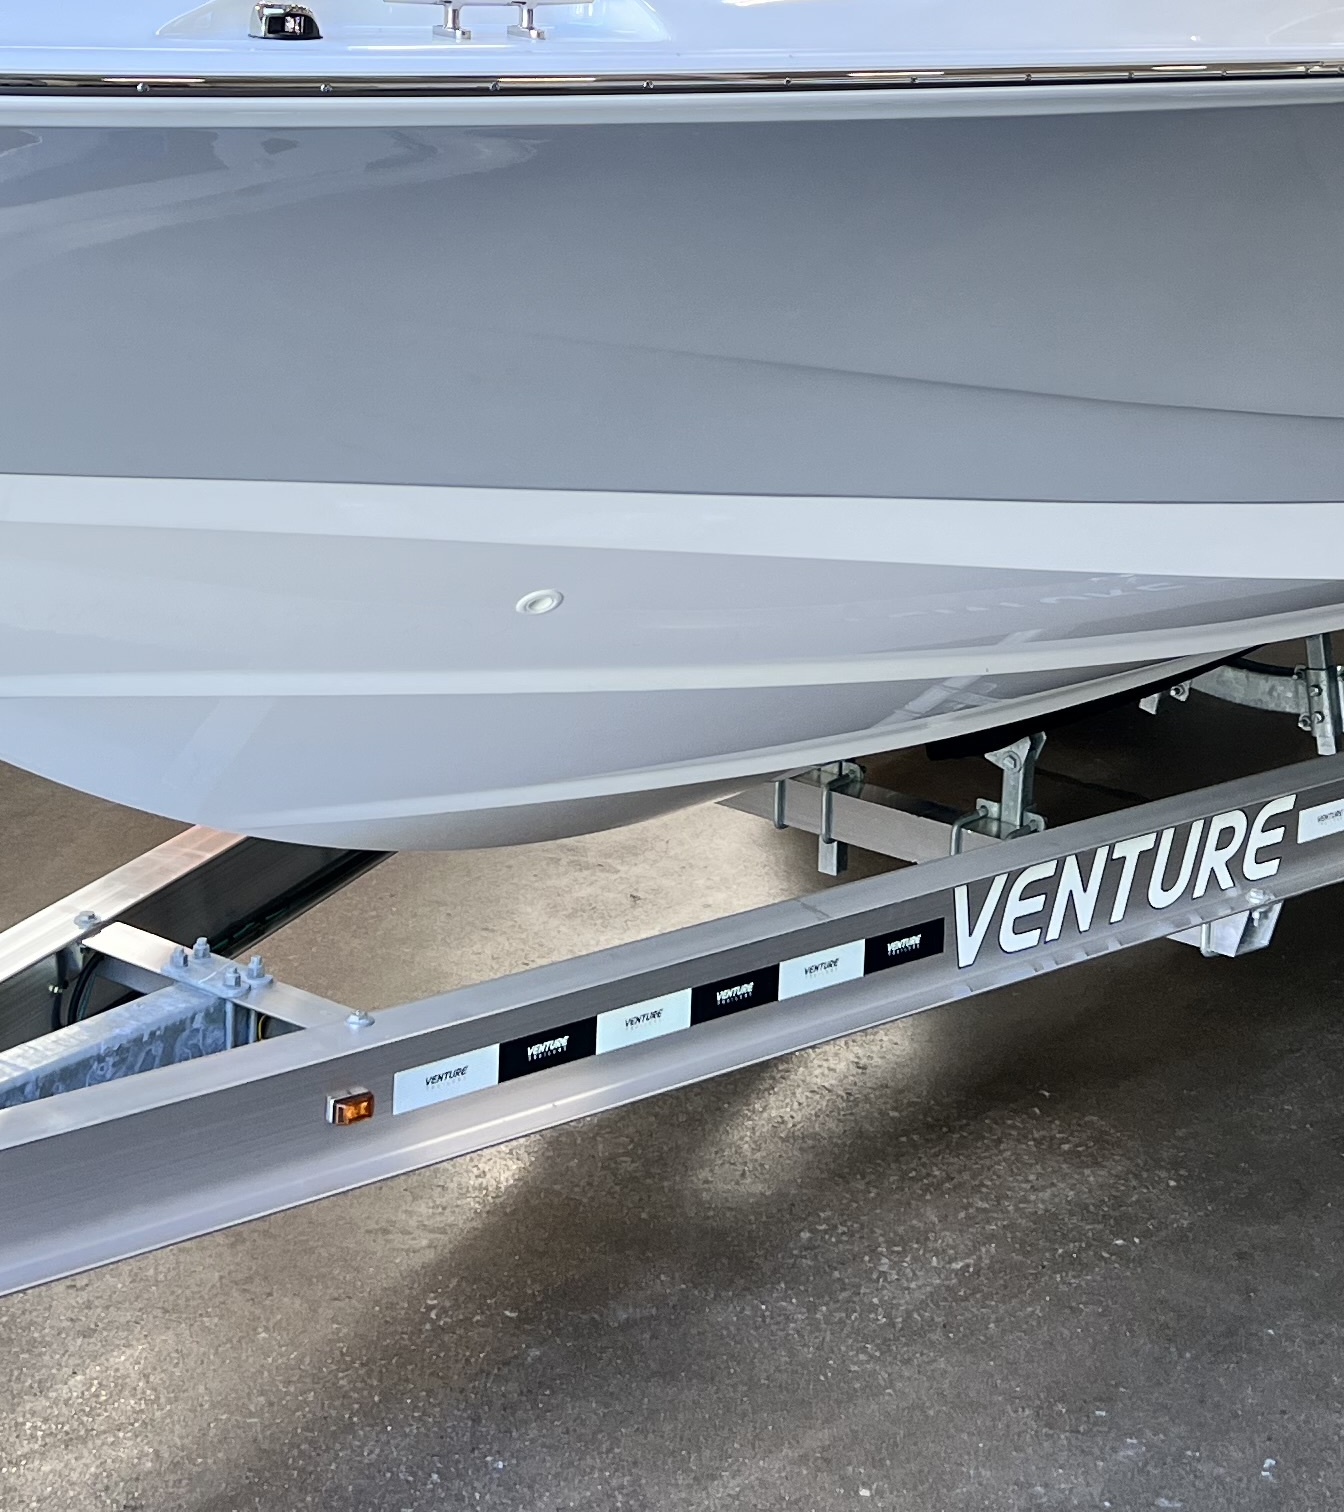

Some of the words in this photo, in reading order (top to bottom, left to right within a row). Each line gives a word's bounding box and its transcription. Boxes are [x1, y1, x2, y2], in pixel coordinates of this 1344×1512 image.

[954, 794, 1297, 969] VENTURE
[804, 957, 840, 975] VENTURE
[716, 981, 755, 1001] VENTURE
[624, 1008, 664, 1027] VENTURE
[527, 1035, 570, 1057] VENTURE
[425, 1065, 469, 1086] VENTURE
